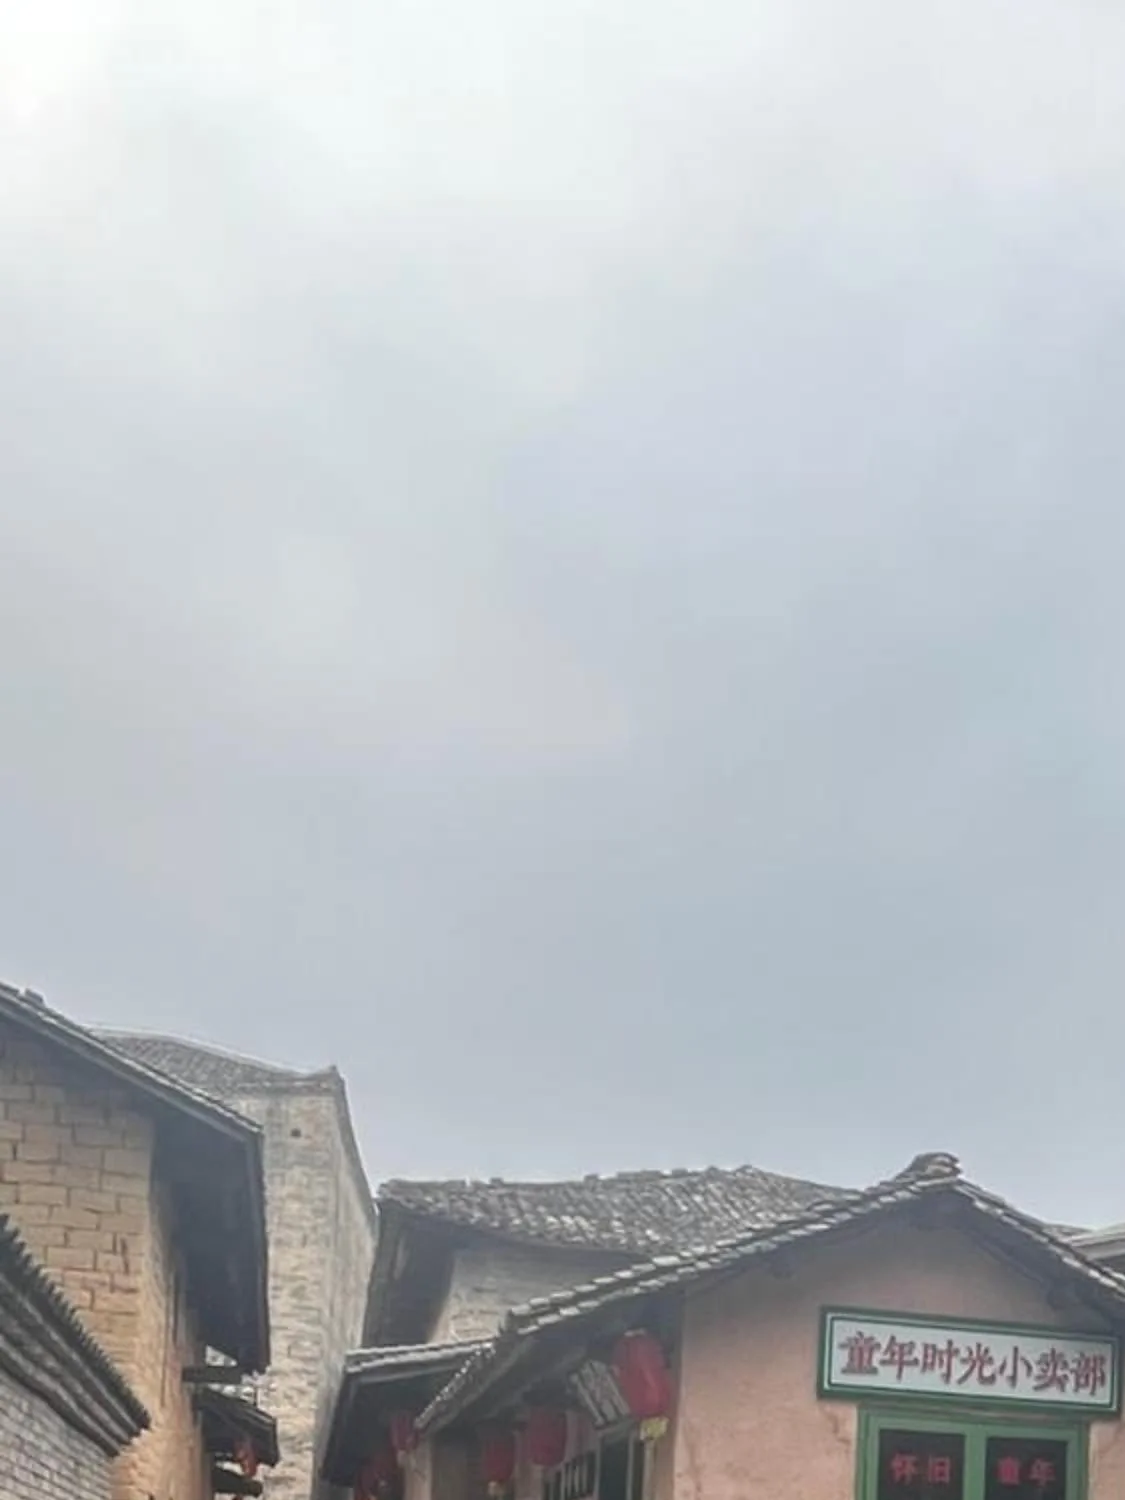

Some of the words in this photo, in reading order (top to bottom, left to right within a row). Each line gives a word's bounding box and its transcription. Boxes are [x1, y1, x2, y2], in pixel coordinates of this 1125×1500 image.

[839, 1330, 1106, 1395] 童年时光小卖部
[891, 1453, 951, 1484] 怀旧
[996, 1456, 1055, 1485] 童年
